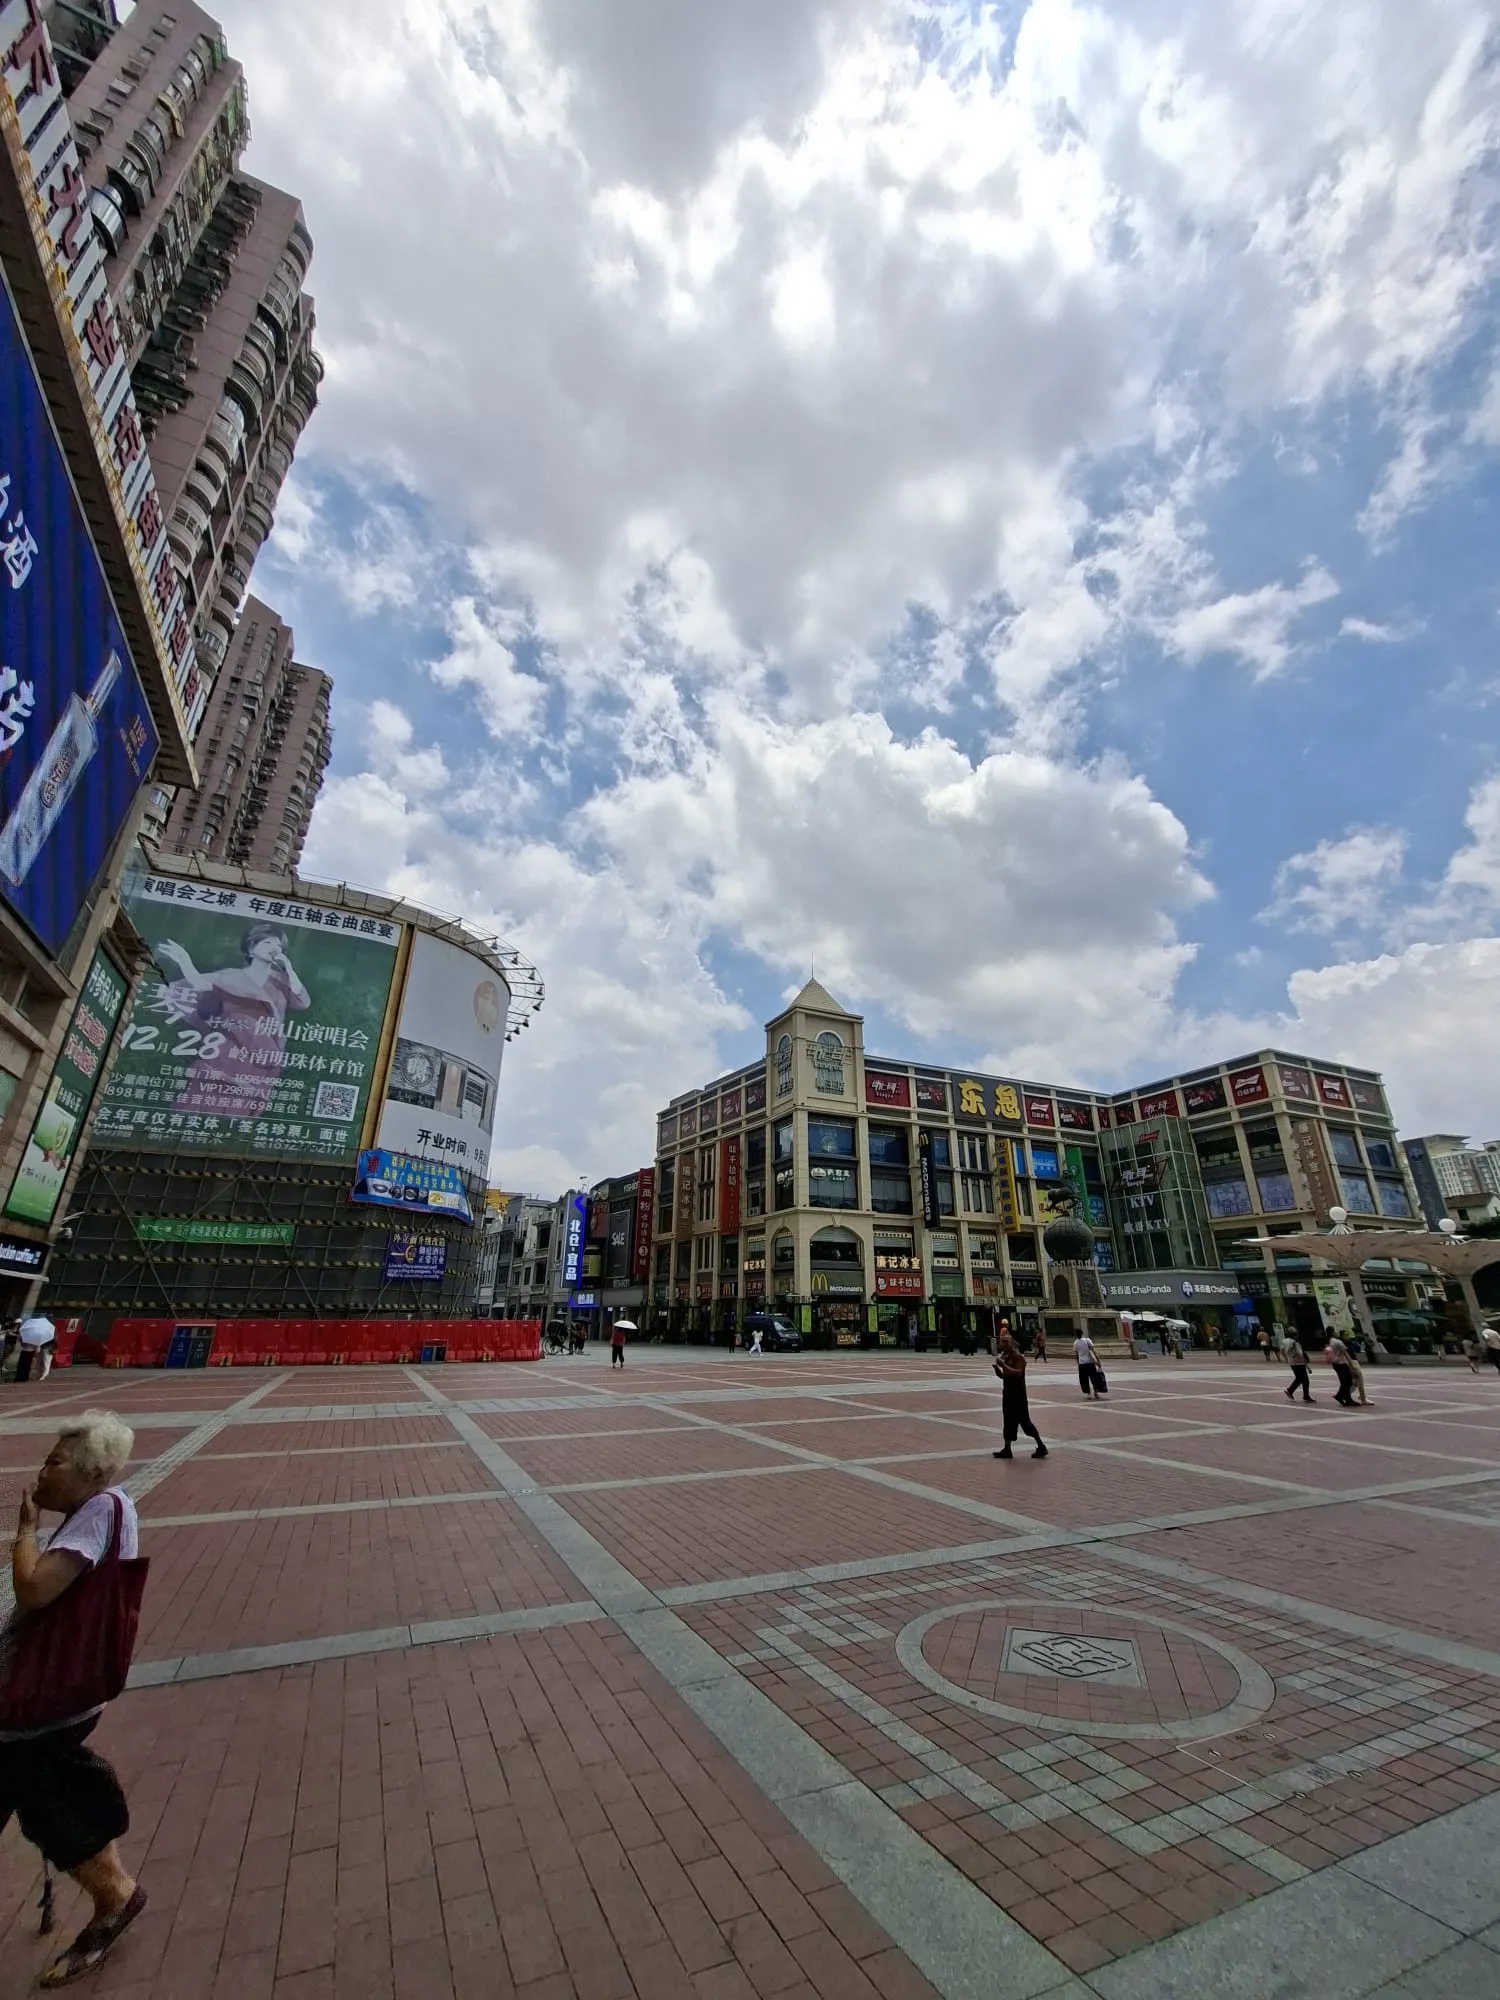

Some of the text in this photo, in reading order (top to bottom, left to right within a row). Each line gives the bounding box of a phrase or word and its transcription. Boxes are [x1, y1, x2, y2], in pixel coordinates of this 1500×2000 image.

[248, 897, 394, 939] 年度压轴金曲盛宴
[254, 1015, 369, 1051] 佛山演唱会
[228, 1047, 366, 1079] 岭南明珠体育馆
[958, 1079, 1021, 1119] 东急
[922, 1157, 931, 1221] McDonald's
[1130, 1194, 1154, 1209] KTV
[612, 1232, 625, 1247] SALE
[1131, 1284, 1172, 1294] ChaPanda
